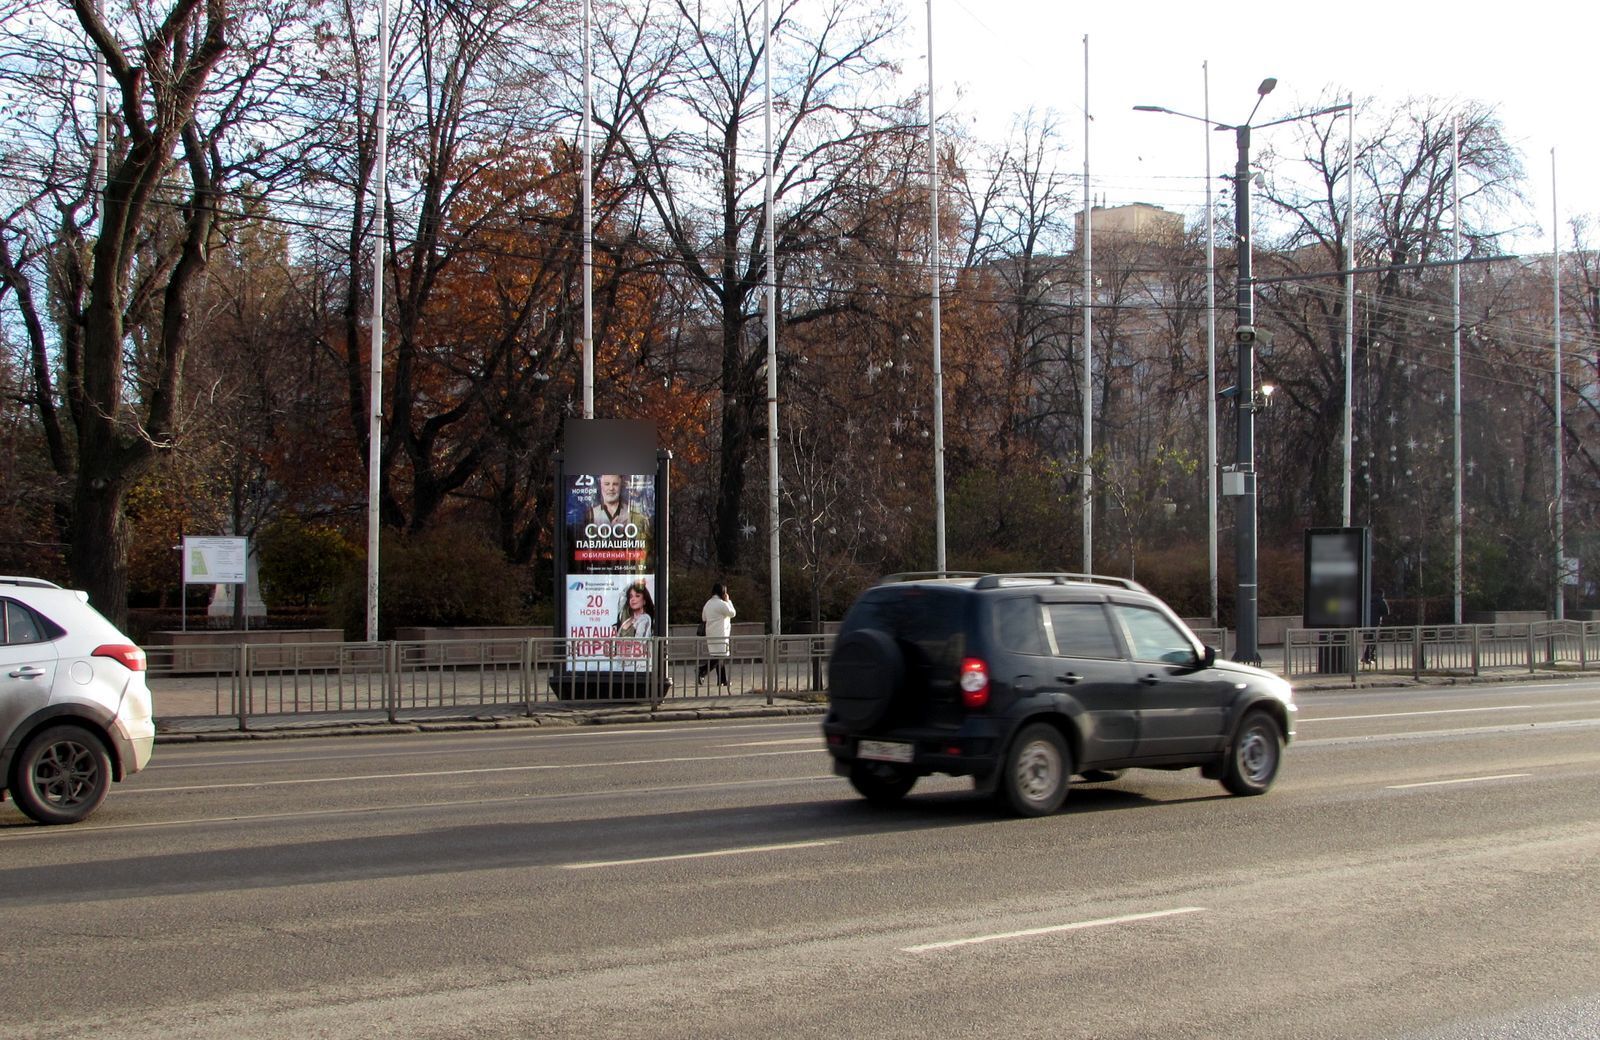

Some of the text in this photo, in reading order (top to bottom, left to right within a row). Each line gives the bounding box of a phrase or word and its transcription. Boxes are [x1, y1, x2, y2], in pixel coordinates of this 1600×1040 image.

[575, 474, 595, 486] 25
[571, 487, 598, 495] ноября
[584, 523, 638, 538] СОСО
[576, 540, 646, 549] ПАВЛИАШВИЛИ
[582, 551, 626, 559] ЮБИЛЕЙНЫЙ
[586, 595, 603, 608] 20
[571, 627, 618, 638] НАТАША
